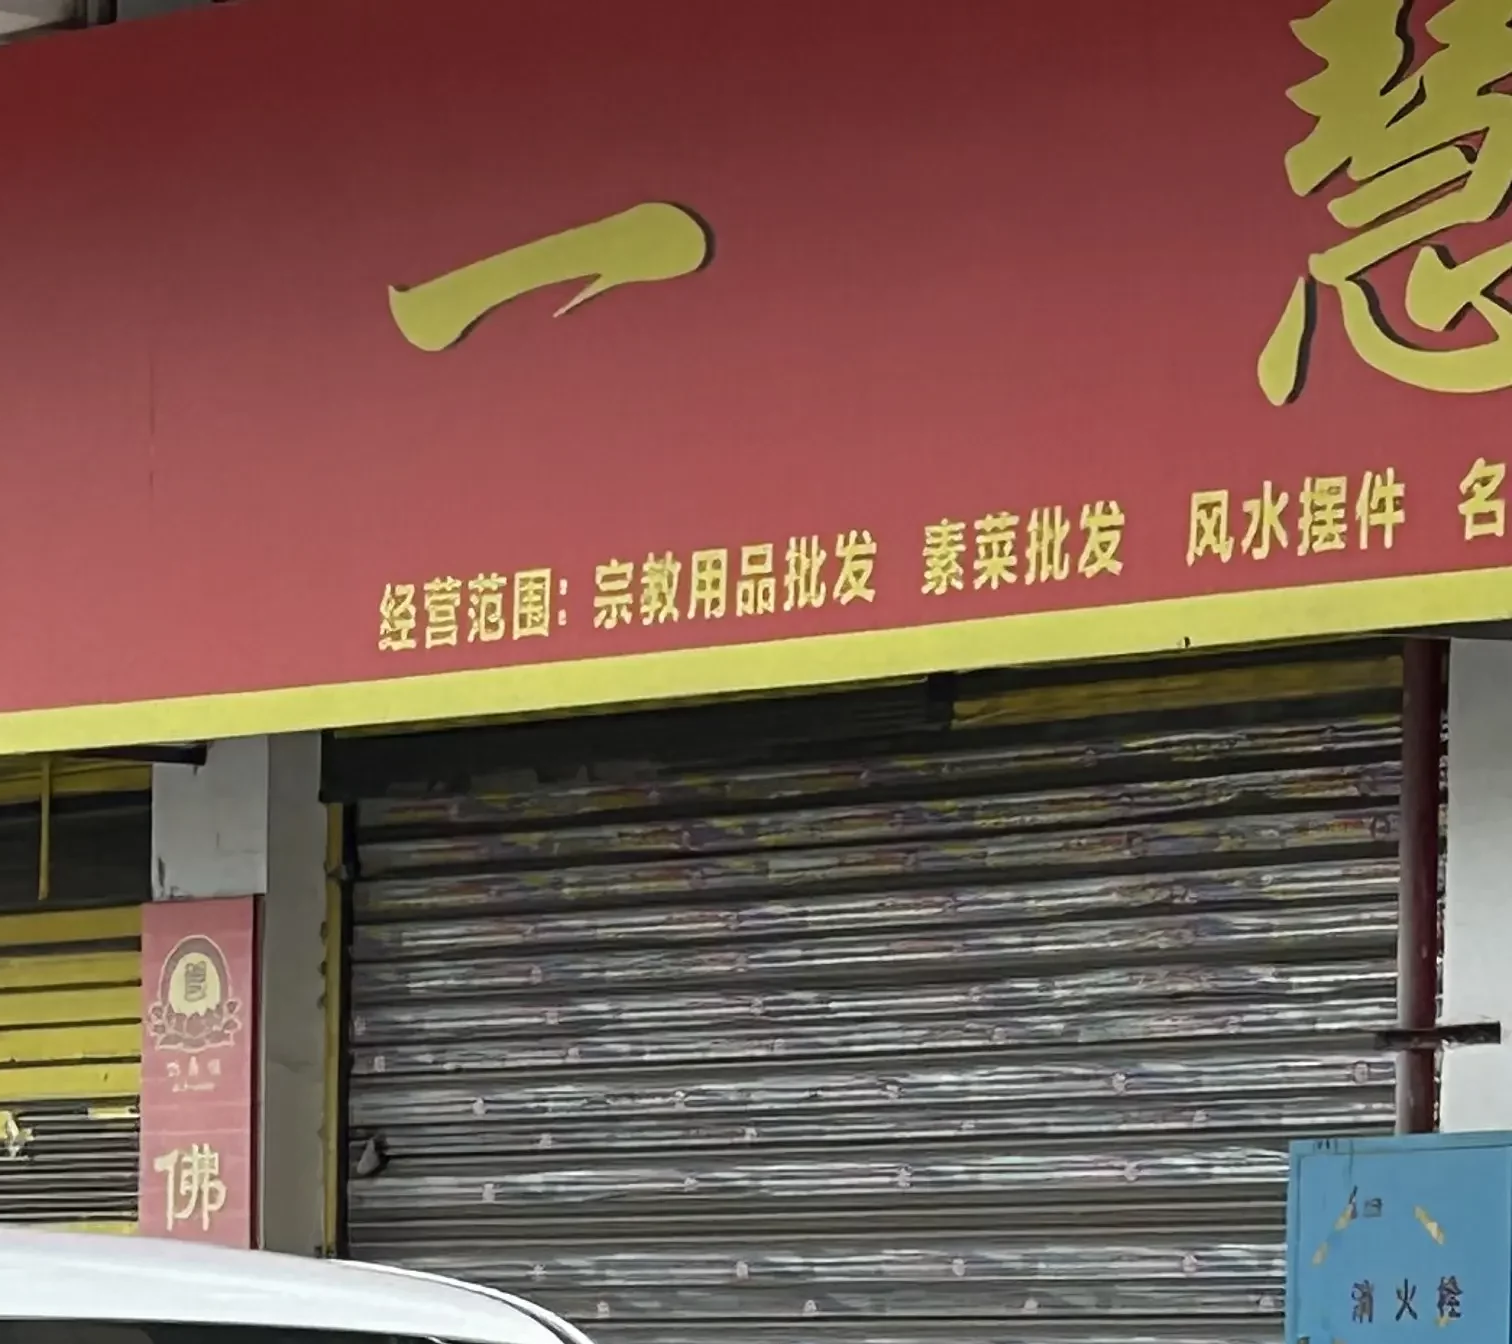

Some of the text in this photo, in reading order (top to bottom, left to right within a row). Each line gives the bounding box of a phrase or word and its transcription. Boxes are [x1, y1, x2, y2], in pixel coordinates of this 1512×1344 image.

[920, 500, 1127, 596] 素菜批发
[1186, 466, 1407, 566] 风水摆件
[1458, 457, 1508, 541] 名
[153, 1142, 228, 1232] 佛
